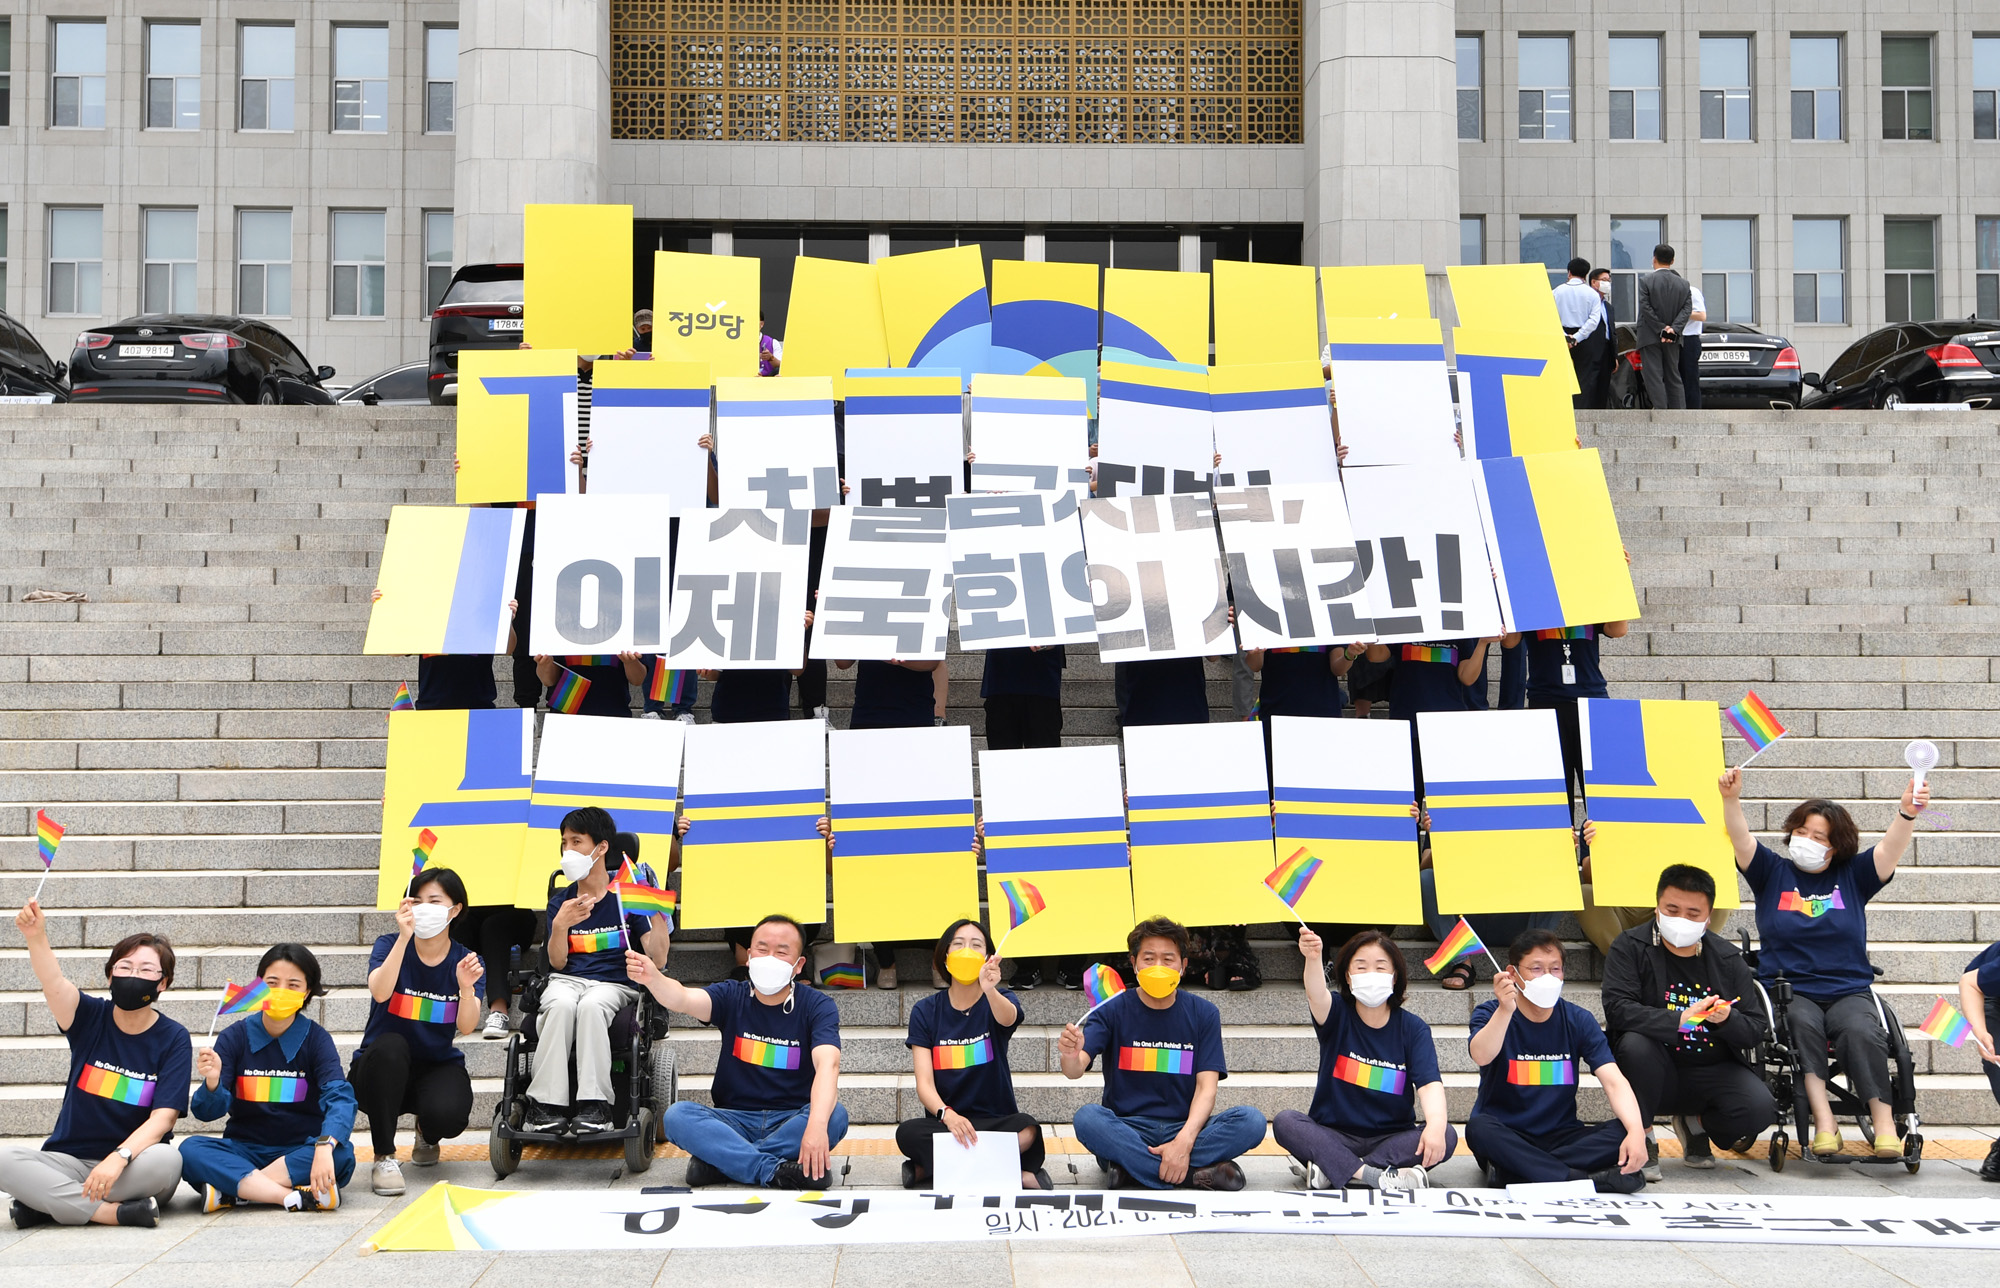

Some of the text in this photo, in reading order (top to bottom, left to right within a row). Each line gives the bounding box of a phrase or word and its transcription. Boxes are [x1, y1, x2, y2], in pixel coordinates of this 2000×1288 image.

[669, 311, 744, 339] 정의당
[145, 346, 169, 354] 9814
[1723, 351, 1745, 360] 0859
[555, 533, 1463, 660] 이제 국회의 시간!
[985, 1210, 1039, 1235] 일시
